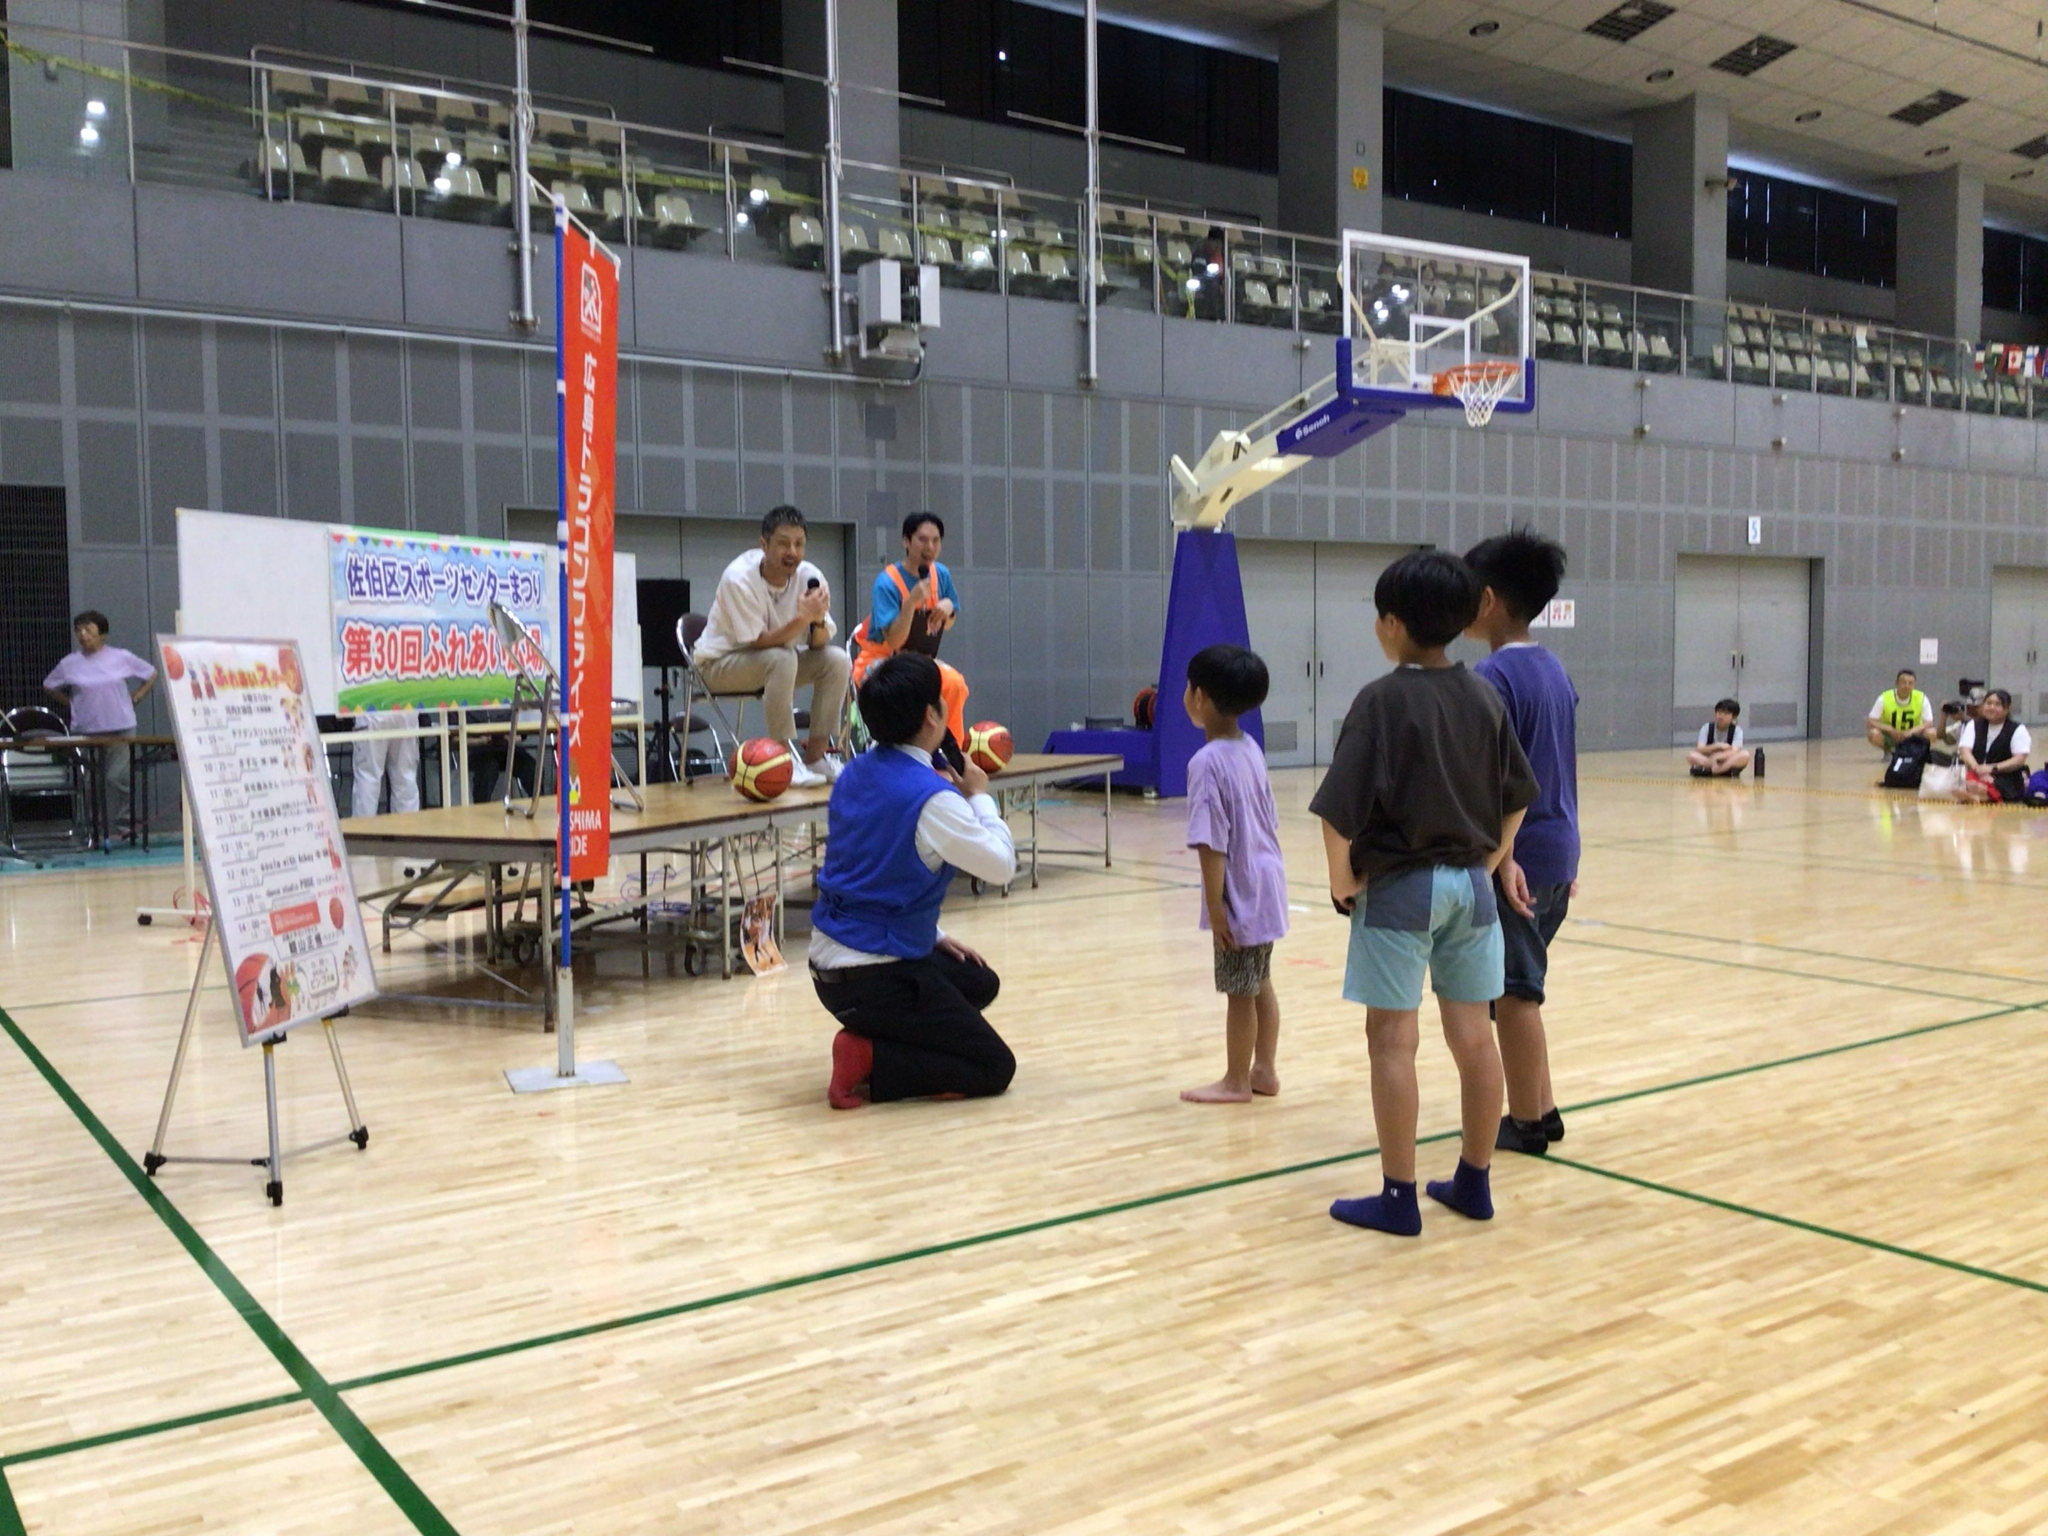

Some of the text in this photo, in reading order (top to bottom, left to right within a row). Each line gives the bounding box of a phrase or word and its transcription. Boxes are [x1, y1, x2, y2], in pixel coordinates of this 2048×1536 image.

[346, 554, 542, 605] 佐伯区スポーツセンターまつり
[1891, 710, 1914, 730] 15
